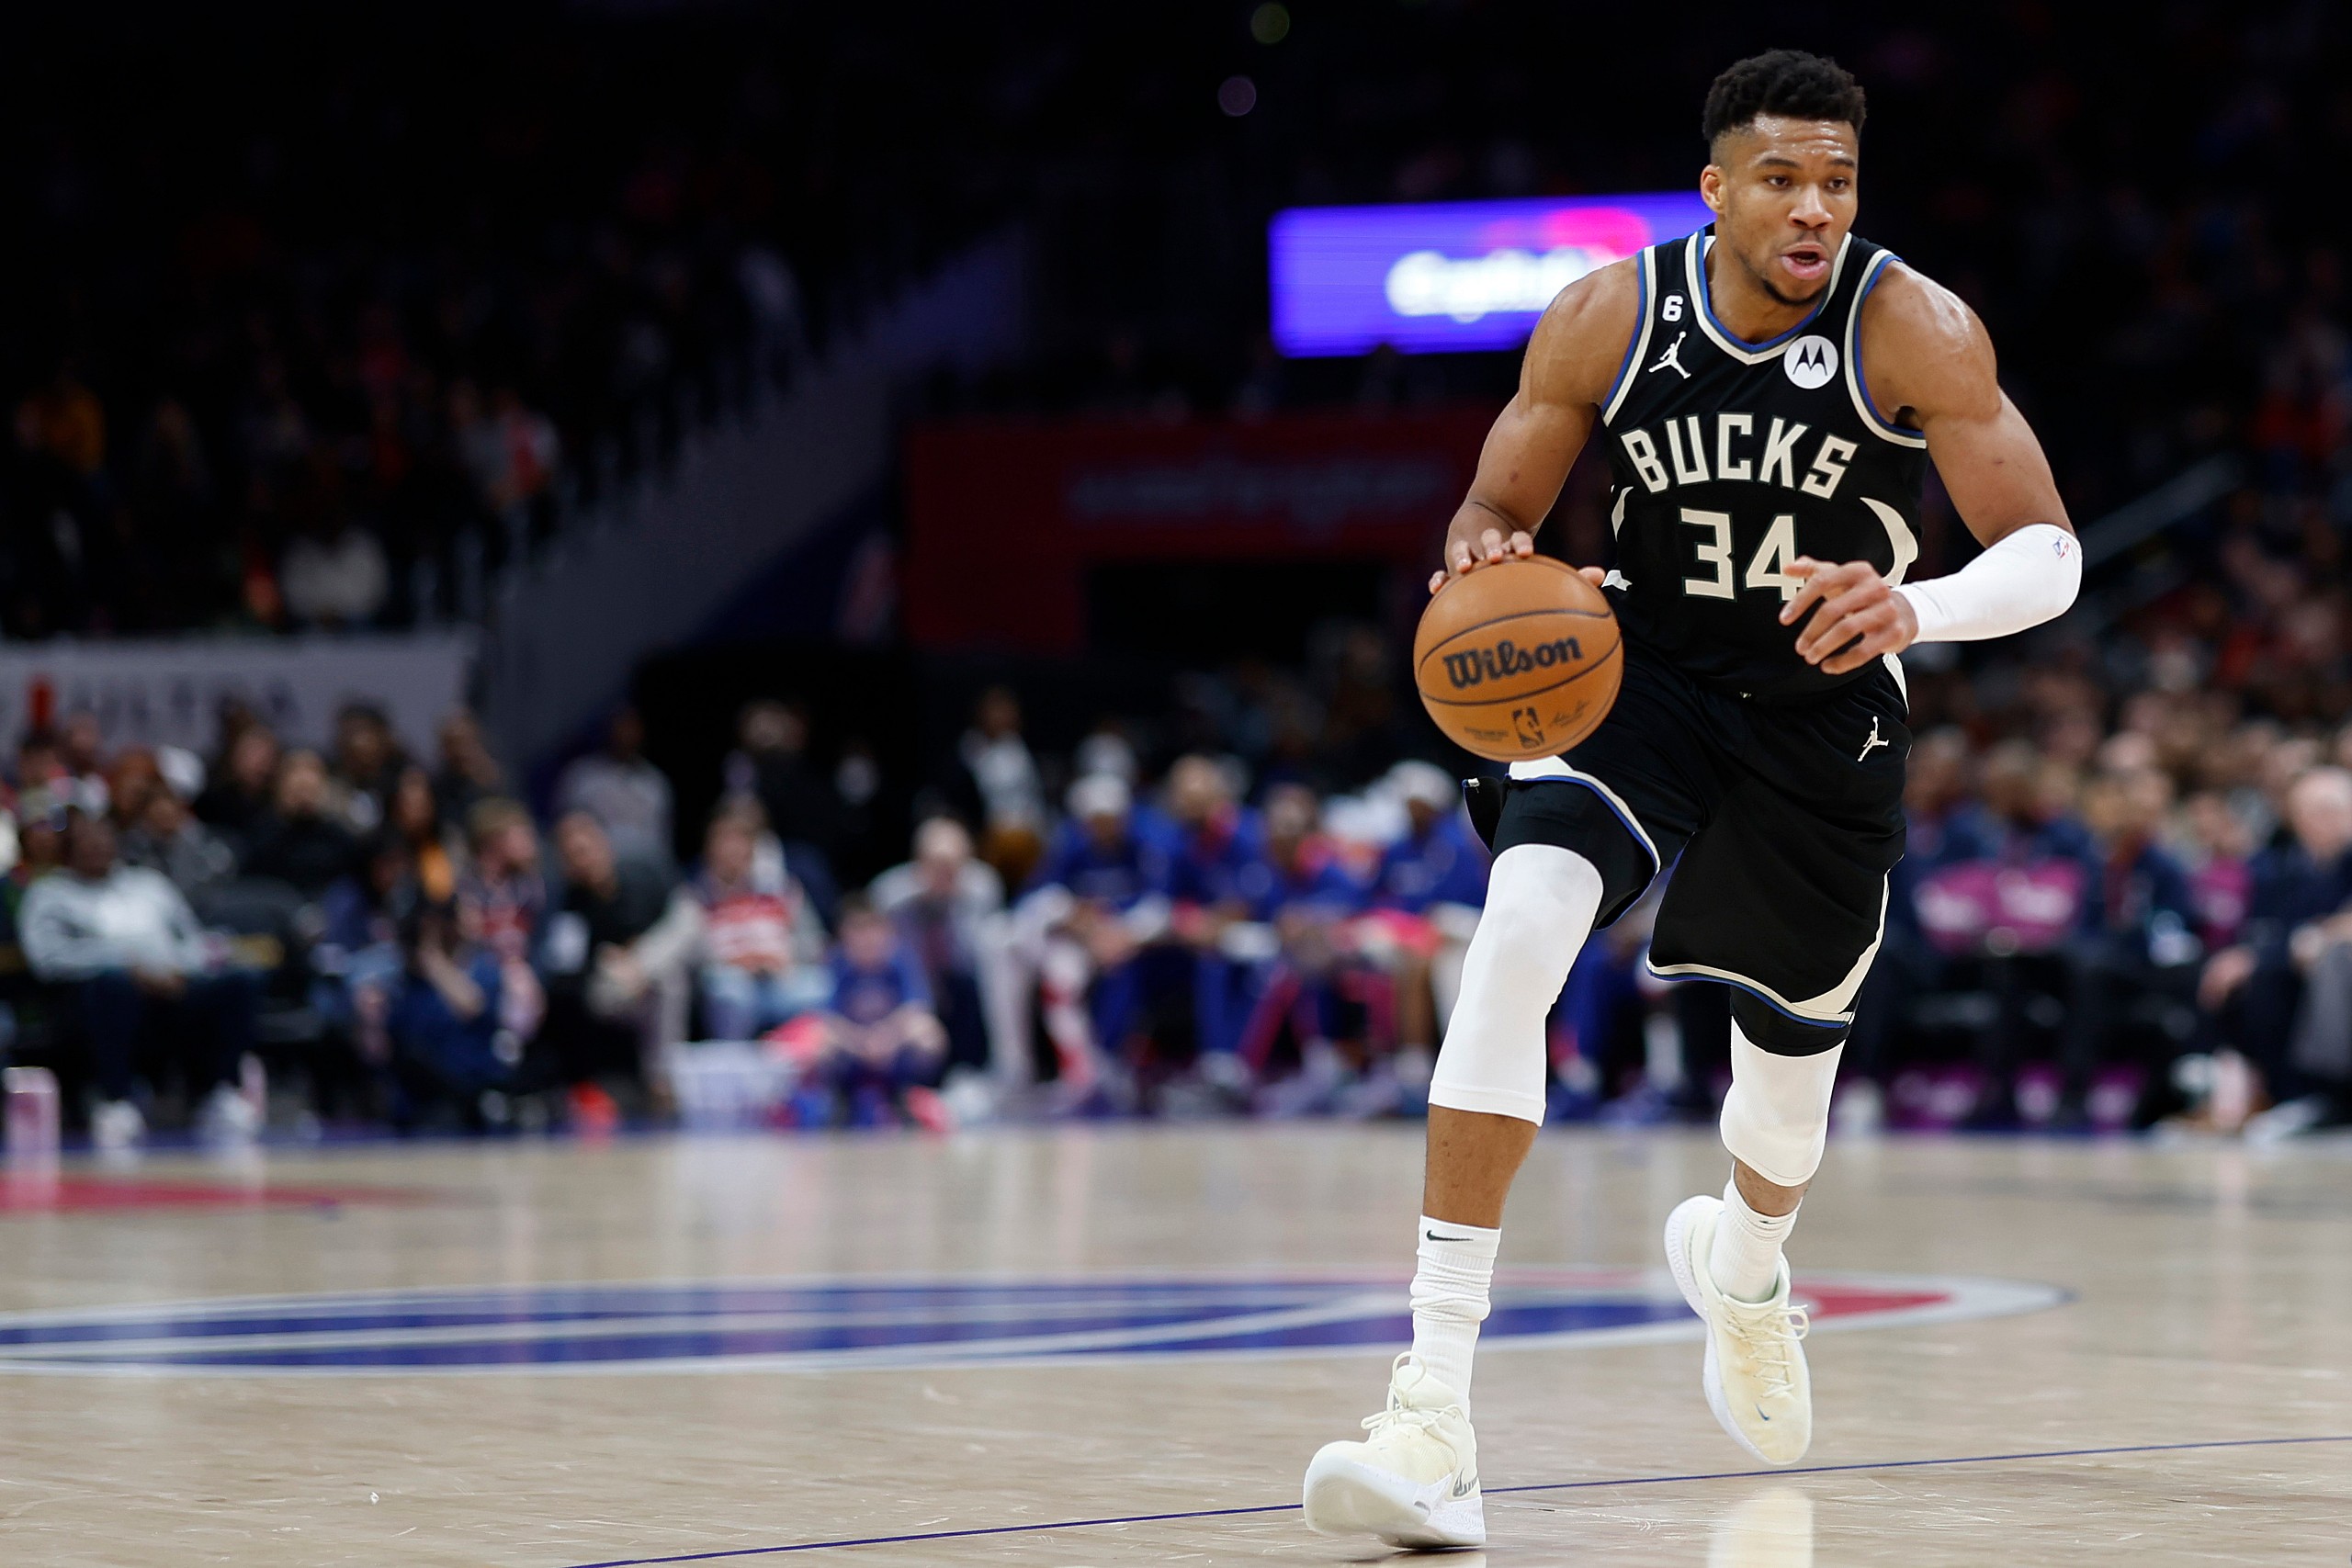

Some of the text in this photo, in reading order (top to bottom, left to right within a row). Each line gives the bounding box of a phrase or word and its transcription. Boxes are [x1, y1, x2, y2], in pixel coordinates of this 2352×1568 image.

[1661, 294, 1684, 322] 6
[1619, 412, 1860, 502] BUCKS
[1679, 506, 1808, 603] 34
[1442, 636, 1585, 689] Wilson
